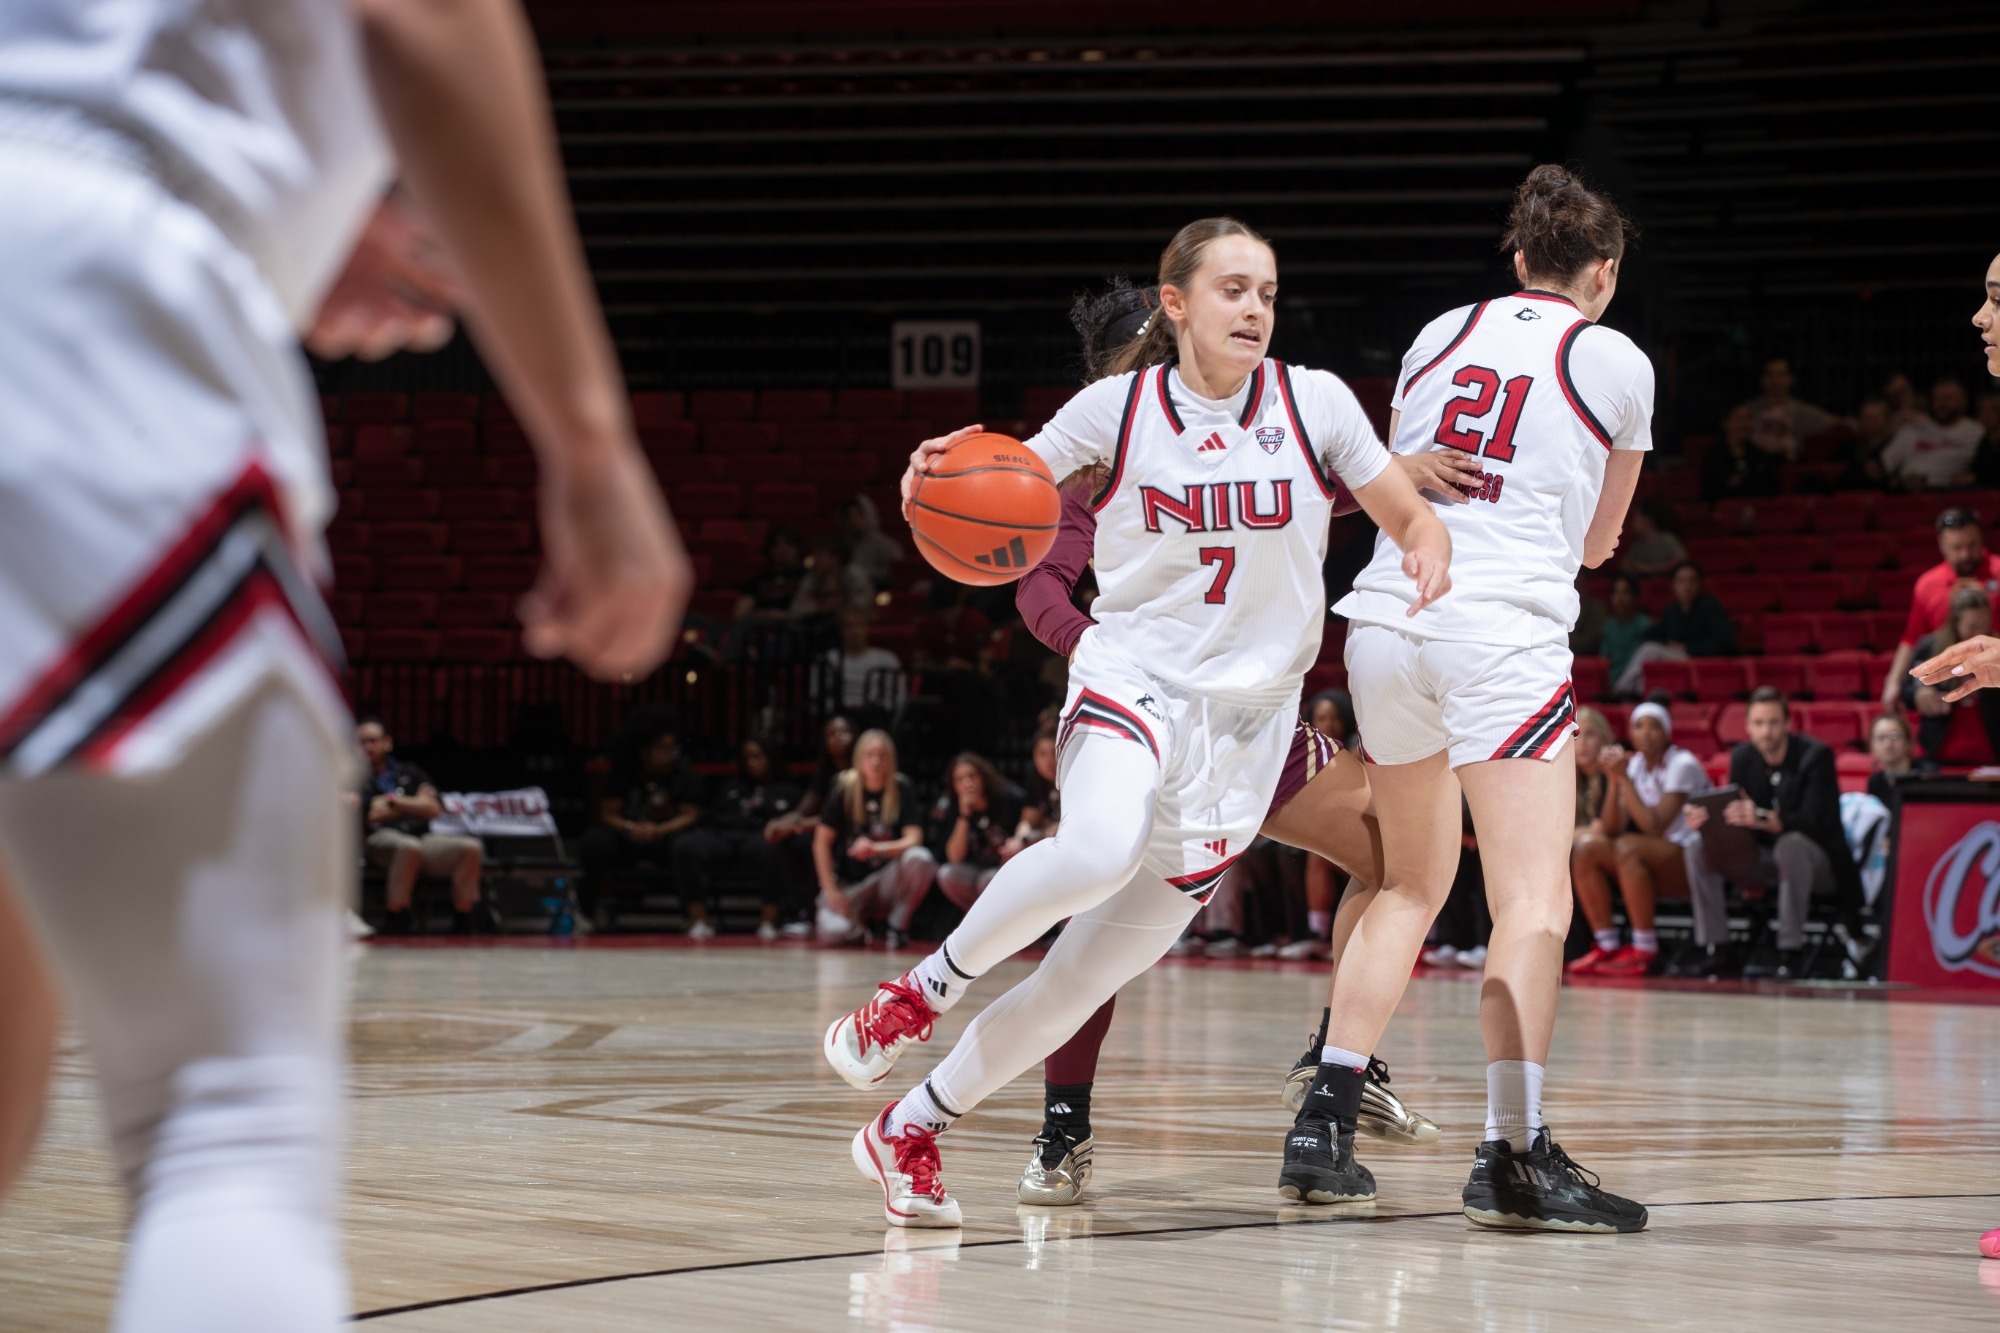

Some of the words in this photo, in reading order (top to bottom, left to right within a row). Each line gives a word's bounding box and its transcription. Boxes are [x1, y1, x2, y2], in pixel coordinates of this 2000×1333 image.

[898, 334, 974, 377] 109
[1258, 434, 1283, 443] MAC
[1434, 364, 1534, 463] 21
[1139, 477, 1295, 533] NIU
[1199, 546, 1235, 605] 7
